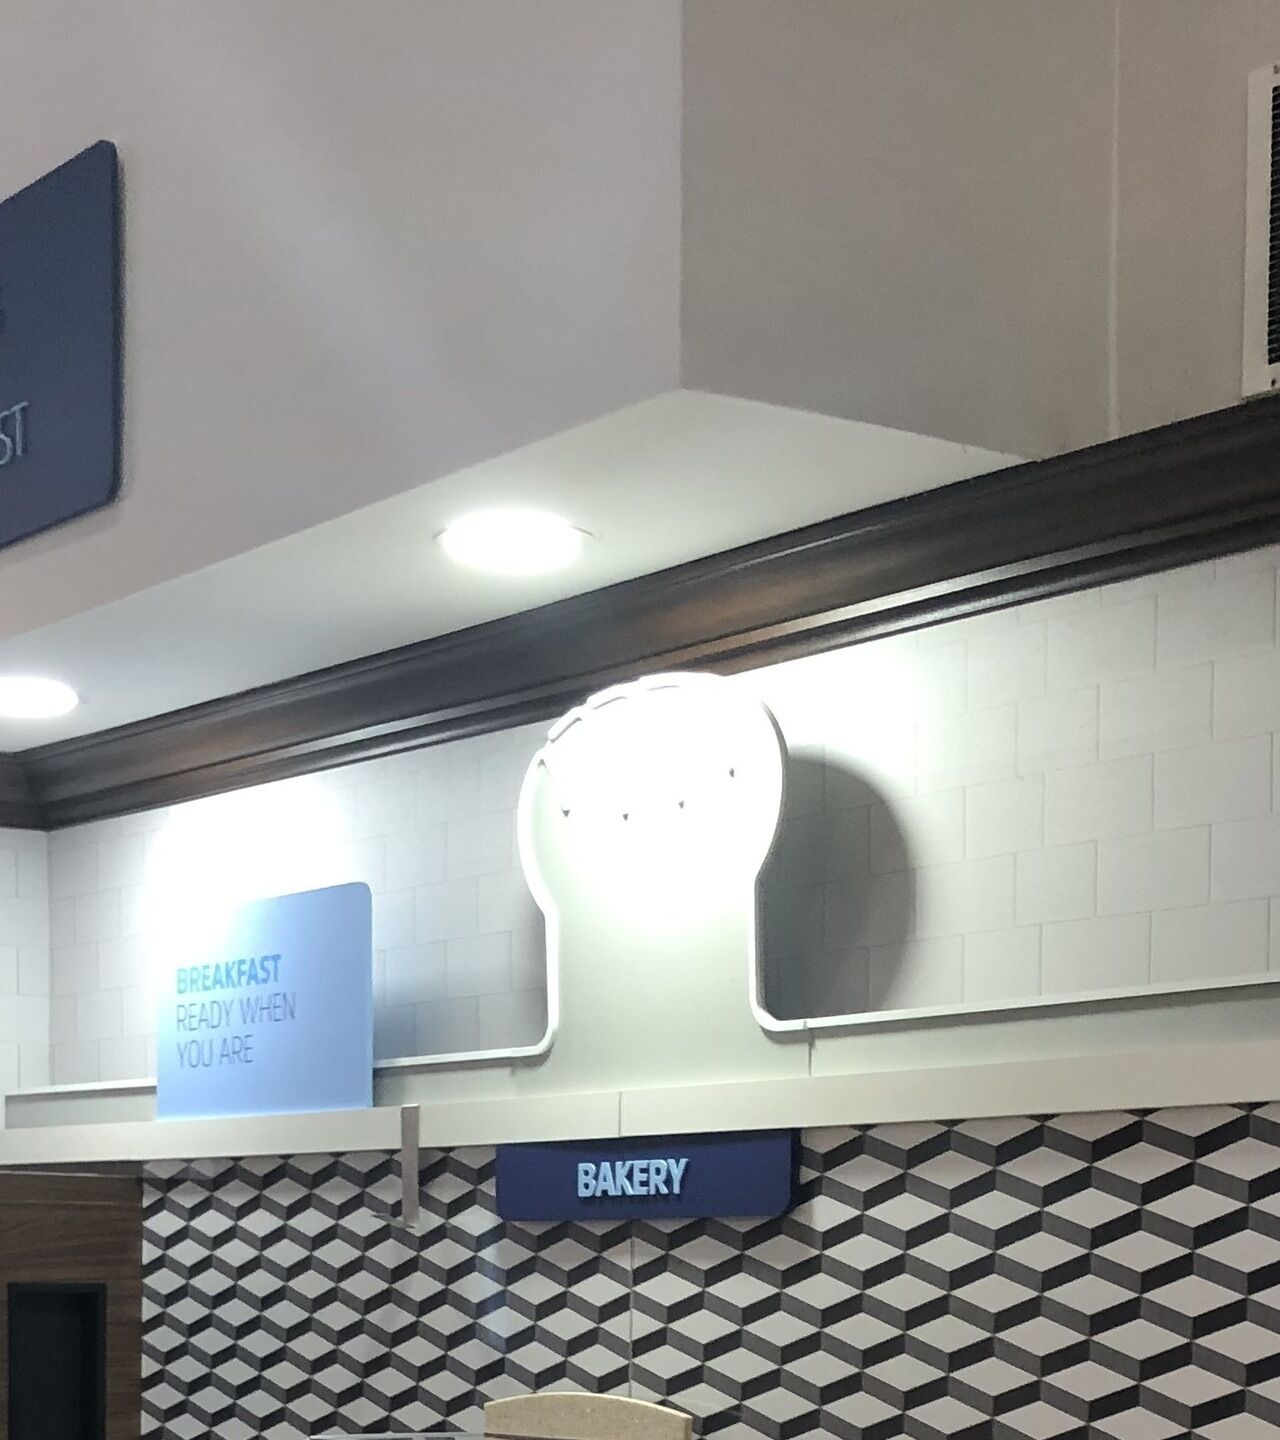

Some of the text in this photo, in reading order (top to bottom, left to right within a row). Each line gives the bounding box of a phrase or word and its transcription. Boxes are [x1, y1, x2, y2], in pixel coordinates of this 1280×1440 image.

[176, 953, 282, 995] BREAKFAST
[176, 992, 297, 1032] READY WHEN
[176, 1034, 255, 1069] YOU ARE
[577, 1158, 689, 1197] BAKERY
